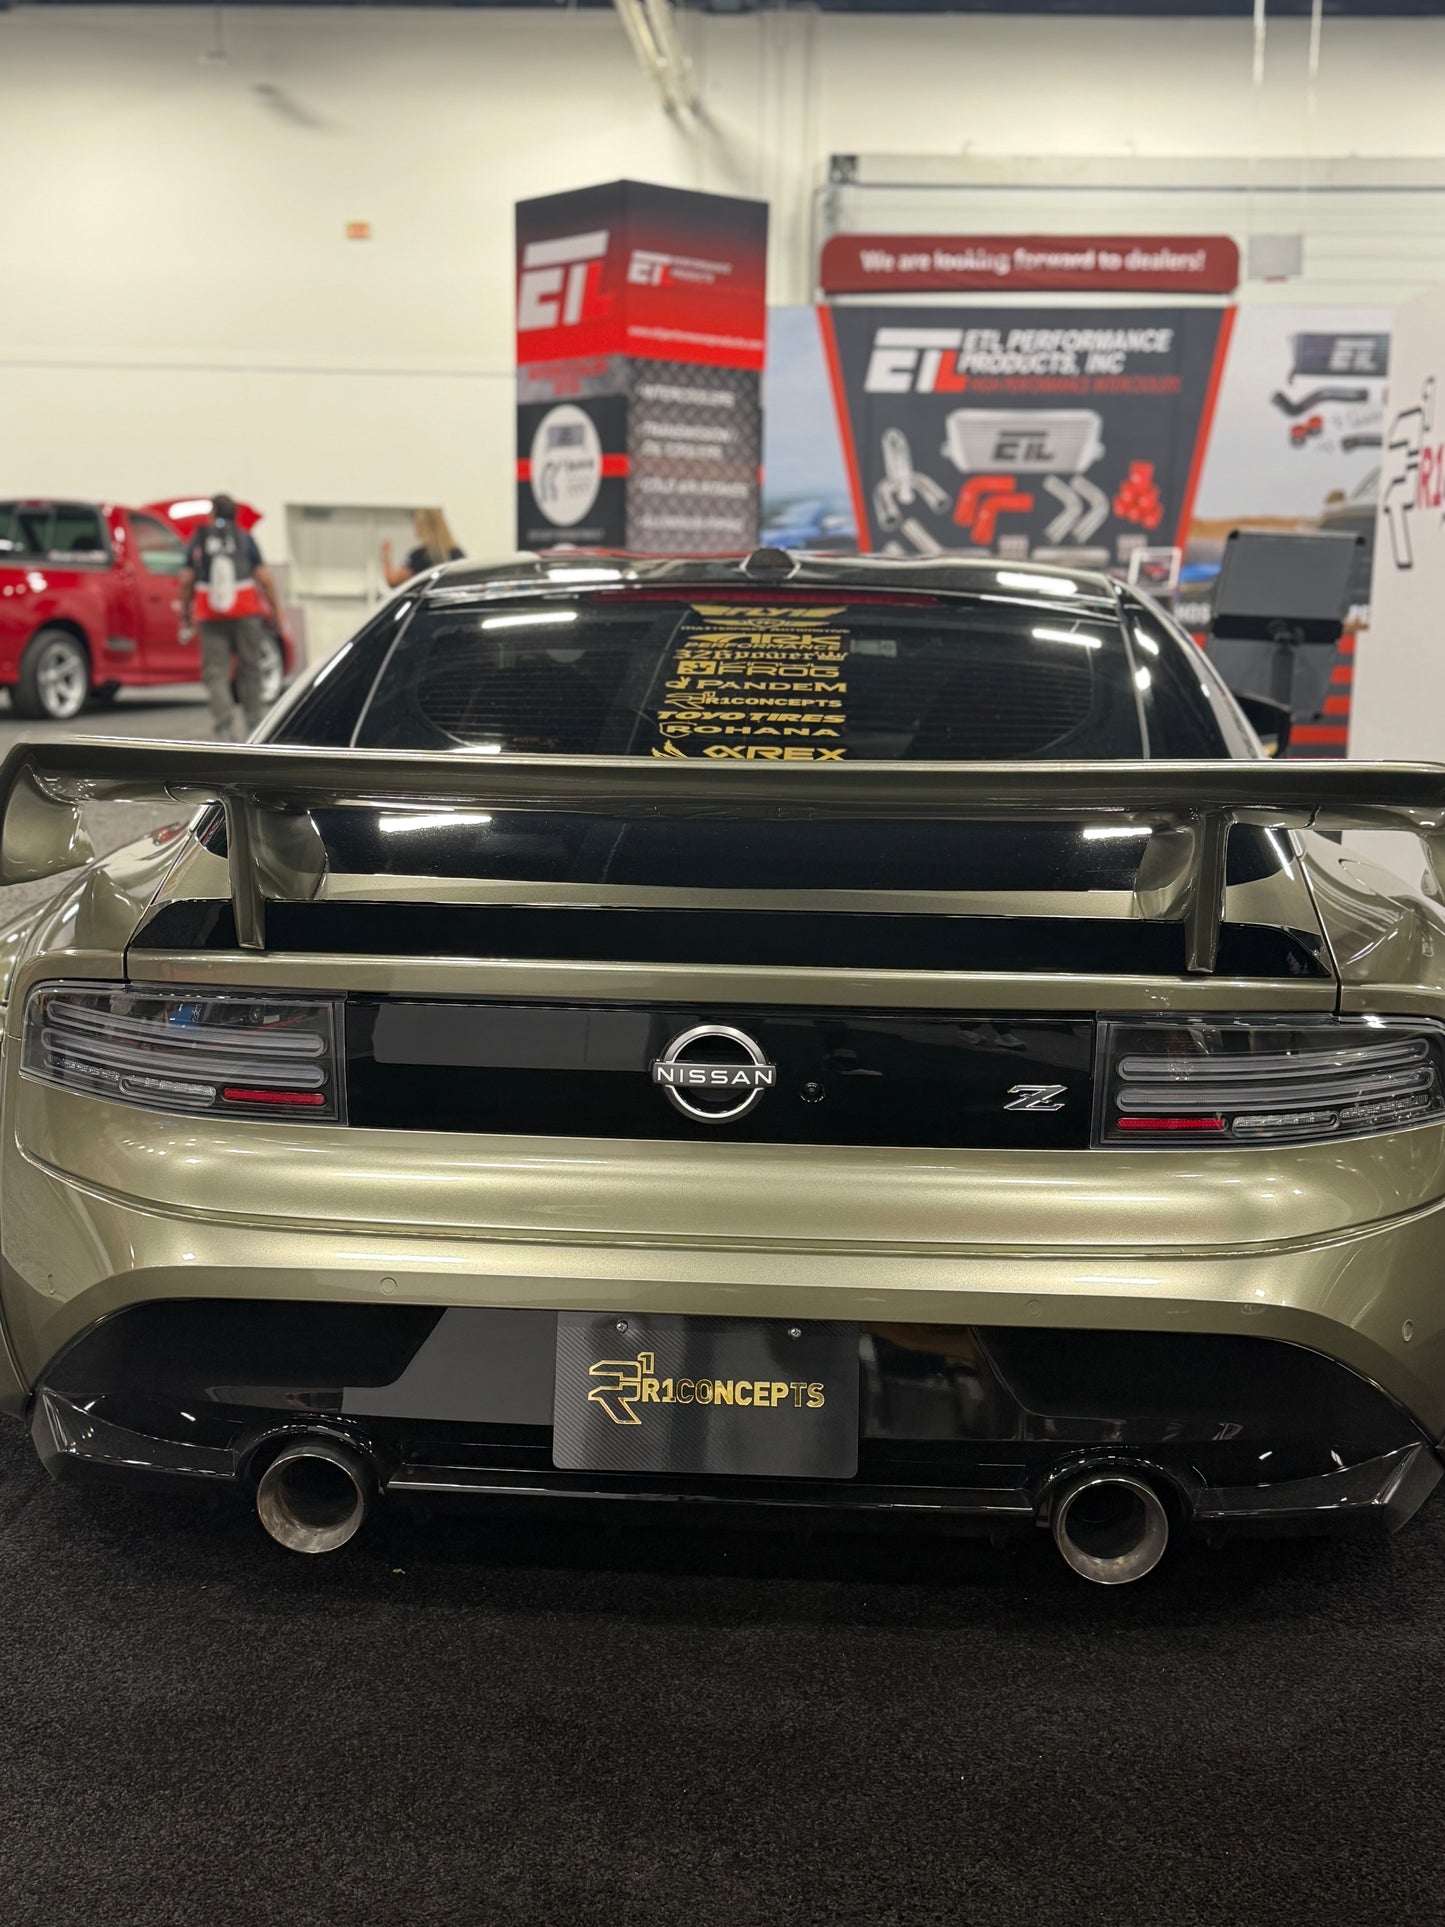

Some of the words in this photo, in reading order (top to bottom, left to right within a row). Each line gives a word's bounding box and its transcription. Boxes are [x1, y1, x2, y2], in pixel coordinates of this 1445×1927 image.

[859, 249, 894, 271] We
[898, 254, 930, 271] are
[934, 249, 1010, 275] looking
[1013, 248, 1095, 271] forward
[1098, 251, 1121, 271] to
[1124, 249, 1206, 271] dealers!
[518, 229, 614, 332] ETL
[1006, 329, 1174, 352] PERFORMANCE
[864, 328, 968, 393] ETL
[1085, 352, 1127, 374] INC
[1328, 338, 1378, 371] ETL
[992, 430, 1055, 461] ETL
[684, 642, 842, 652] PERFORMANCE
[696, 680, 848, 693] PANDEM
[704, 697, 843, 707] R1CONCEPTS
[656, 711, 746, 720] TOYO
[749, 712, 847, 723] TIRES
[666, 725, 841, 736] ROHANA
[657, 1066, 772, 1084] NISSAN
[1003, 1084, 1068, 1111] Z
[642, 1377, 826, 1408] R1CONCEPTS
